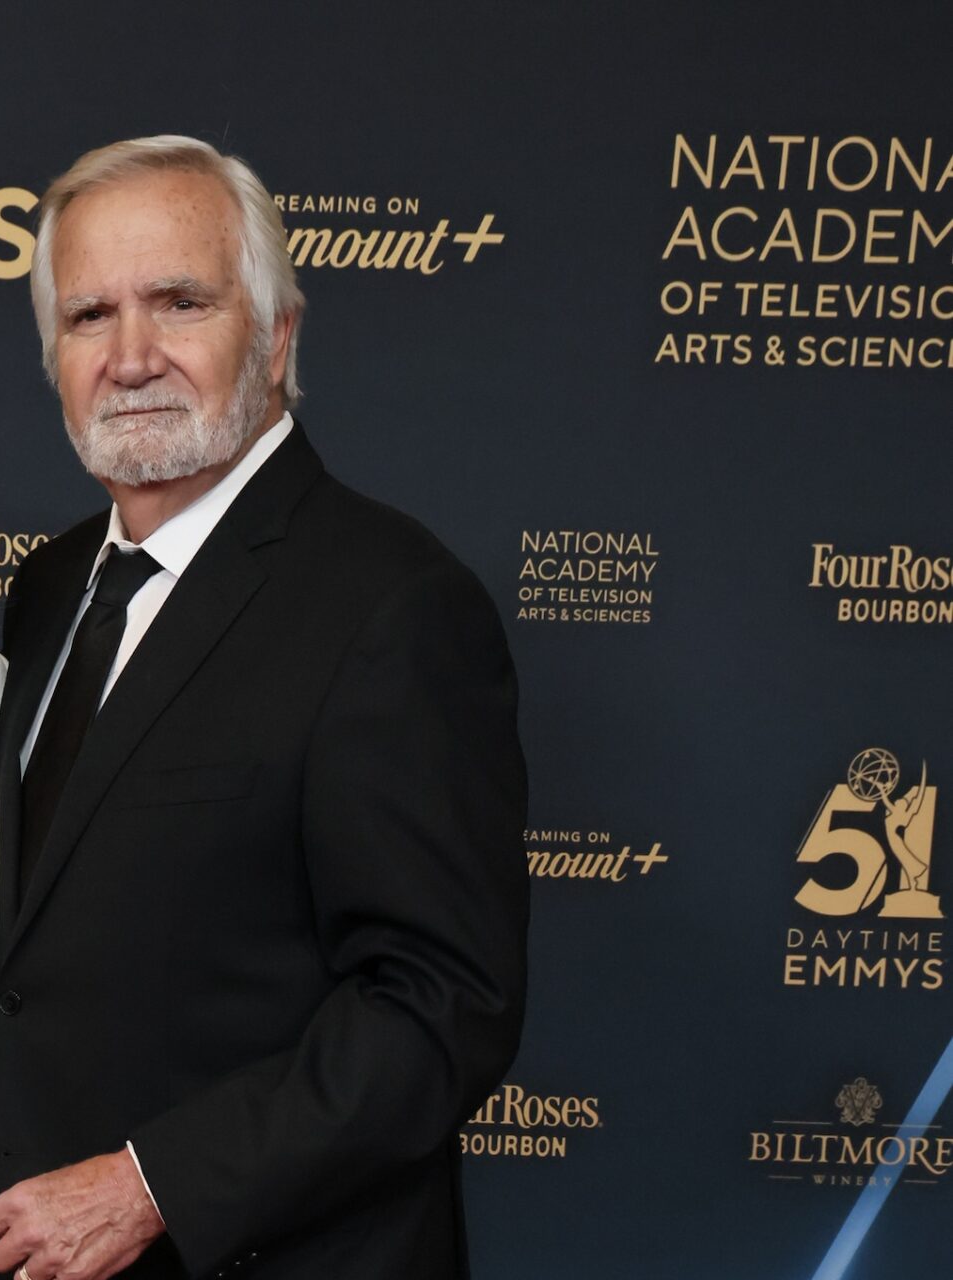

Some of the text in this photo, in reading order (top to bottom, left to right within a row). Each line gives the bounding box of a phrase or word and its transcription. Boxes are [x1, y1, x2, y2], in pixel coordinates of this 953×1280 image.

[387, 197, 420, 215] ON
[285, 213, 505, 276] mount+
[660, 280, 723, 316] OF
[654, 332, 753, 366] ARTS
[763, 335, 786, 366] &
[521, 530, 660, 556] NATIONAL
[519, 557, 657, 583] ACADEMY
[808, 543, 953, 592] Four Ros
[518, 587, 653, 605] OF TELEVISION
[517, 607, 651, 623] ARTS & SCIENCES
[837, 598, 953, 624] BOURBON
[587, 832, 611, 843] ON
[794, 784, 941, 918] 51
[786, 927, 944, 952] DAYTIME
[783, 954, 944, 990] EMMYS
[500, 1084, 600, 1129] Roses
[748, 1132, 953, 1175] BILTMORE
[812, 1174, 893, 1187] WINERY
